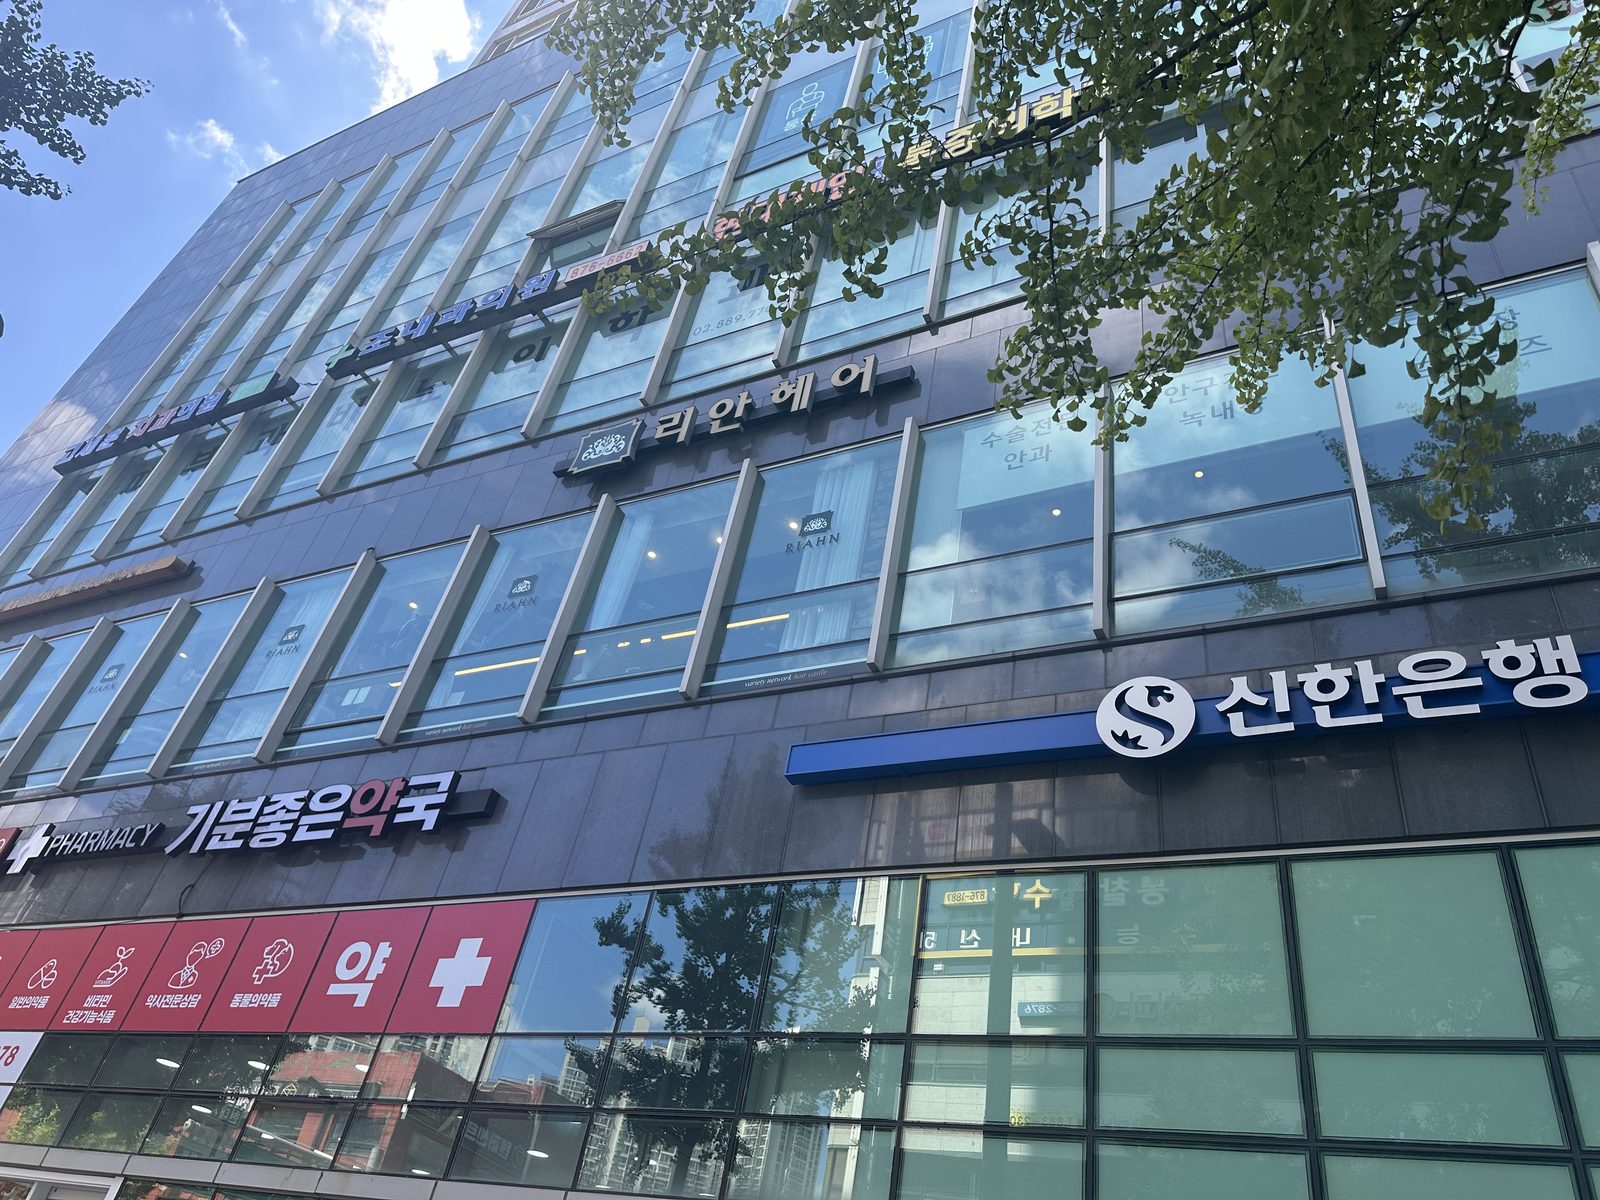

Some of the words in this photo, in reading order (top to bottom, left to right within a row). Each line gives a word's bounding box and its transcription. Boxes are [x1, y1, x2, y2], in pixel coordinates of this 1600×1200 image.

[366, 269, 553, 350] 조내과의원
[656, 354, 877, 446] 리안헤어
[1004, 443, 1053, 470] 안과
[784, 532, 840, 555] RIAHN
[493, 596, 537, 614] RIAHN
[1215, 634, 1589, 737] 신한은행
[165, 770, 456, 855] 기분좋은약국
[44, 823, 160, 857] PHARMACY
[326, 941, 392, 1008] 약
[8, 996, 51, 1009] 일반의약품
[83, 994, 112, 1008] 비타민
[145, 993, 202, 1009] 약사전문상담
[229, 993, 283, 1008] 동물의약품
[63, 1009, 116, 1024] 건강기능식품
[0, 1045, 20, 1067] 78
